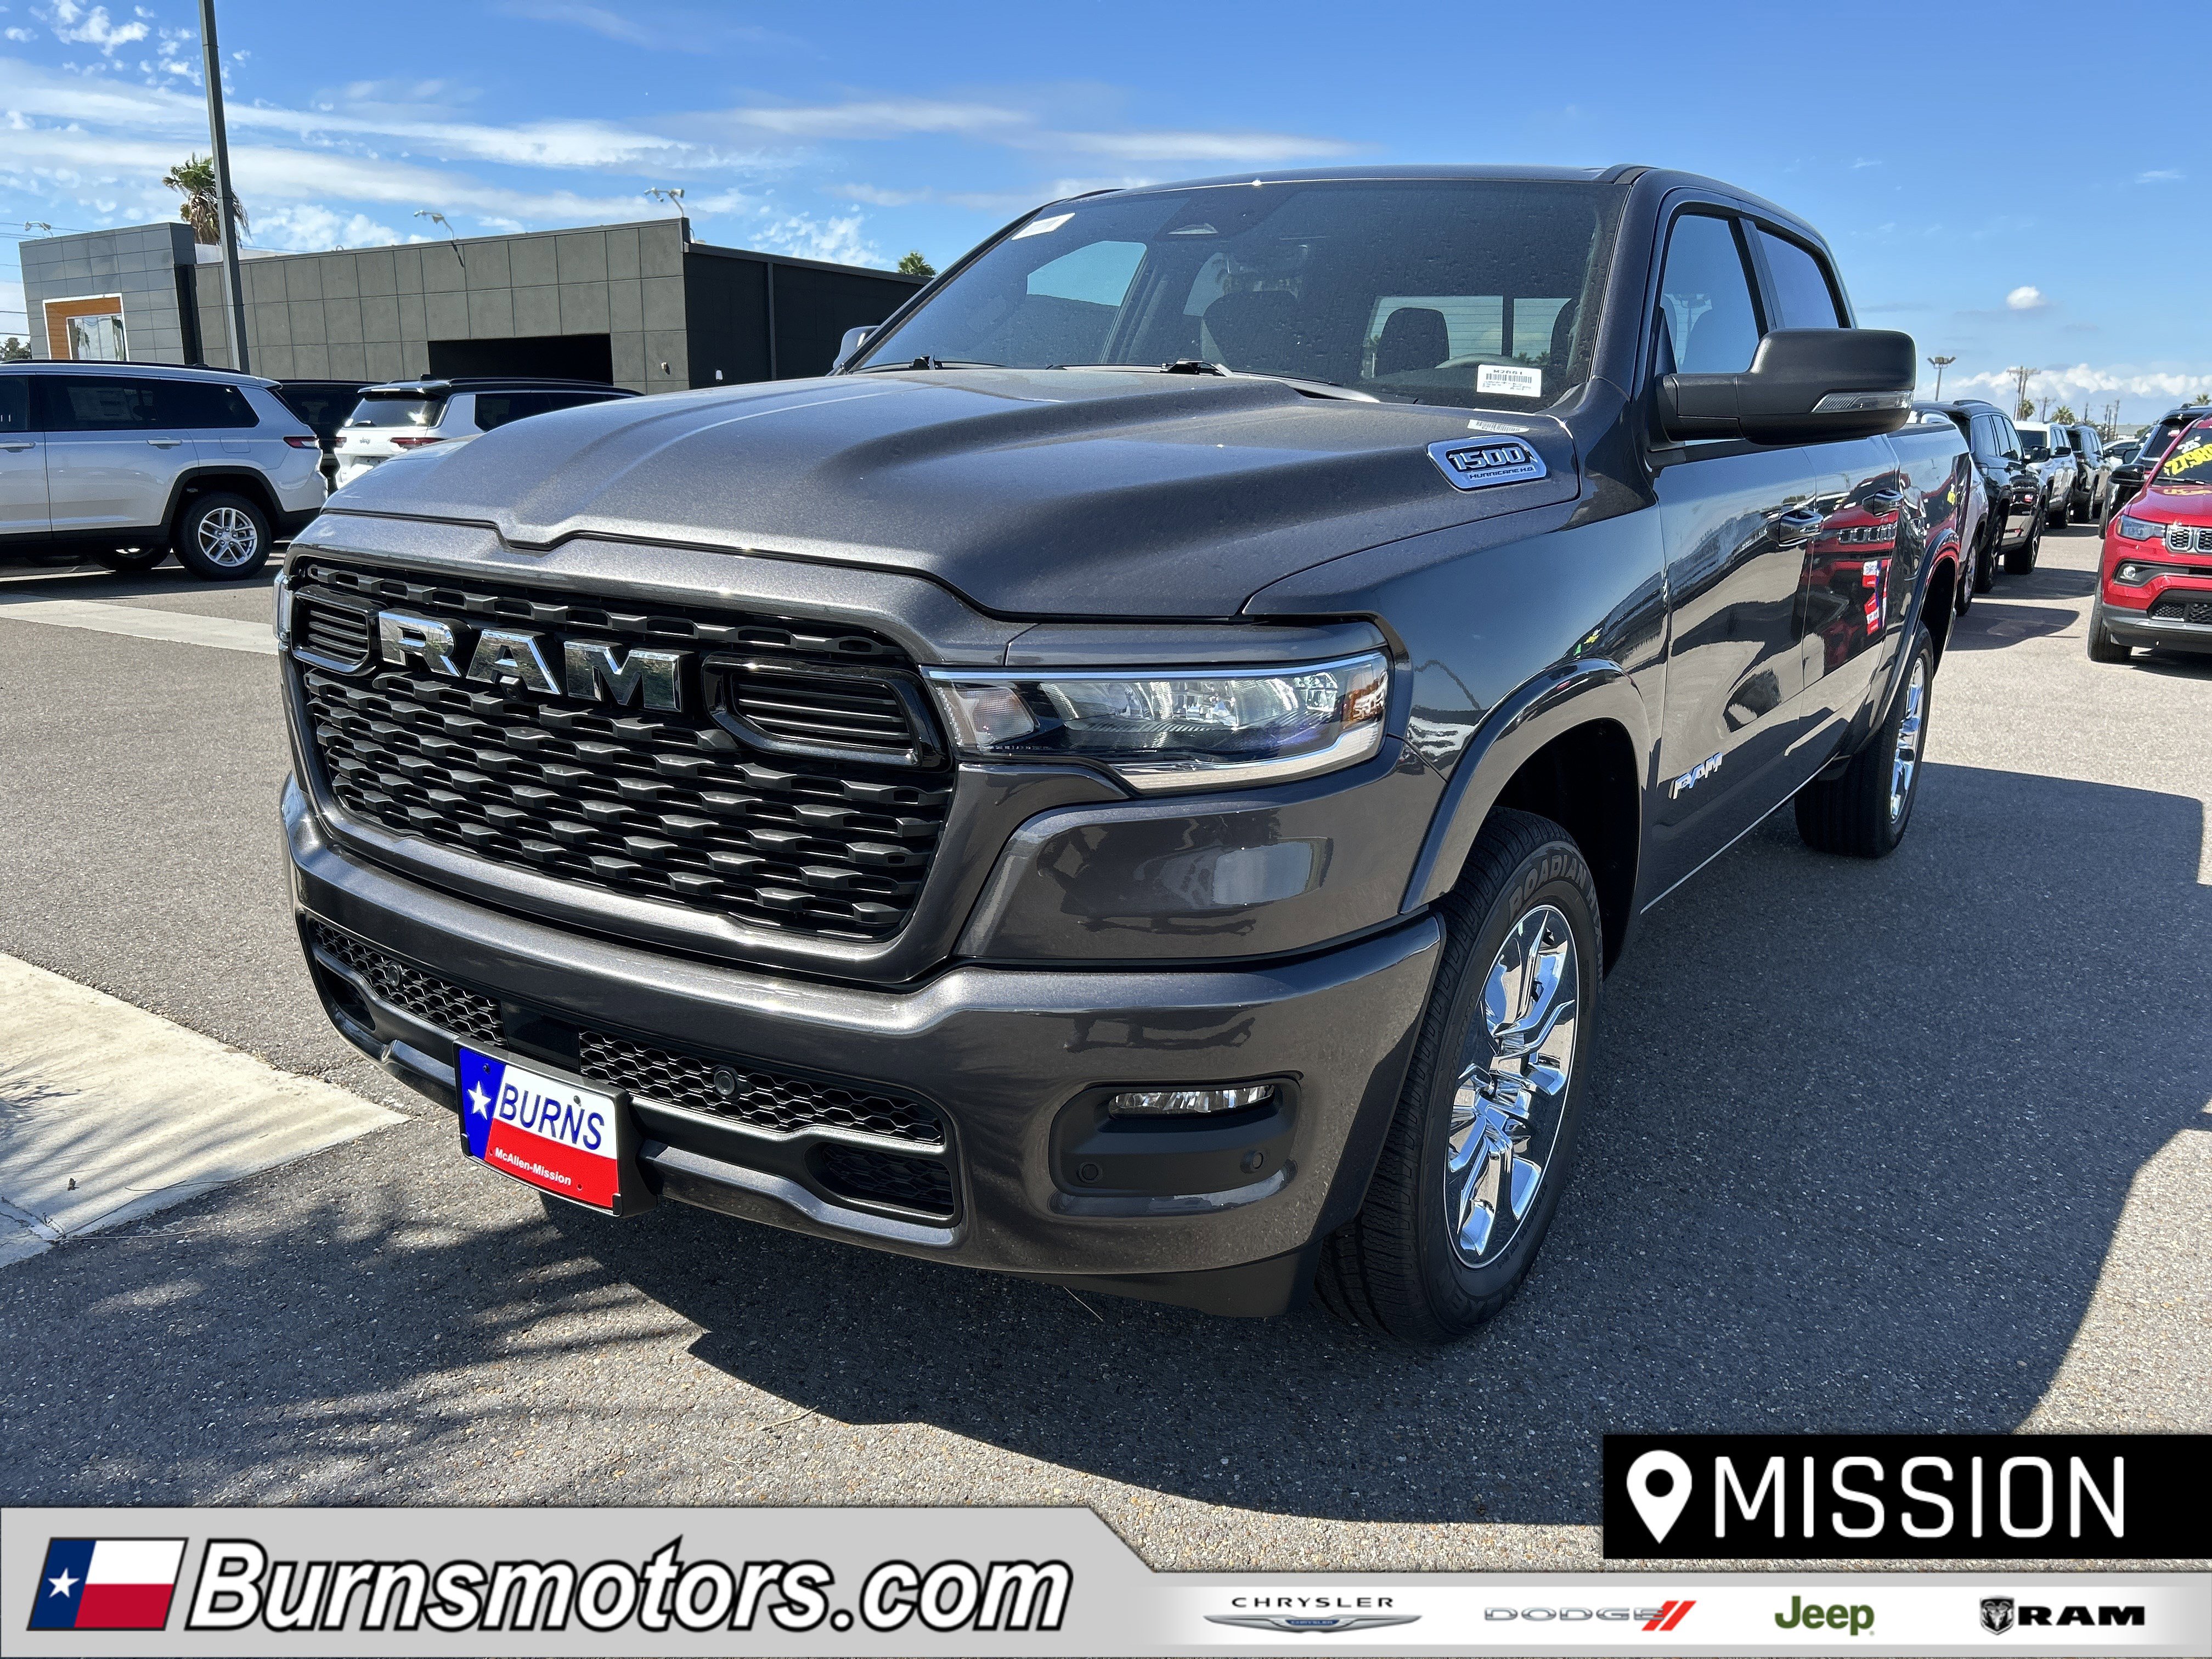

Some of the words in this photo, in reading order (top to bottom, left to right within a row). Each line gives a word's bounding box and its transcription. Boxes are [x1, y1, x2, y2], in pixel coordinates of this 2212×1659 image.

[1448, 447, 1526, 470] 1500
[1469, 468, 1519, 479] HURRICANE
[379, 610, 683, 713] RAM
[1668, 752, 1723, 800] RAM
[1508, 854, 1587, 926] ROADIAN
[499, 1082, 605, 1150] BURNS
[495, 1146, 572, 1187] McAllen-Mission
